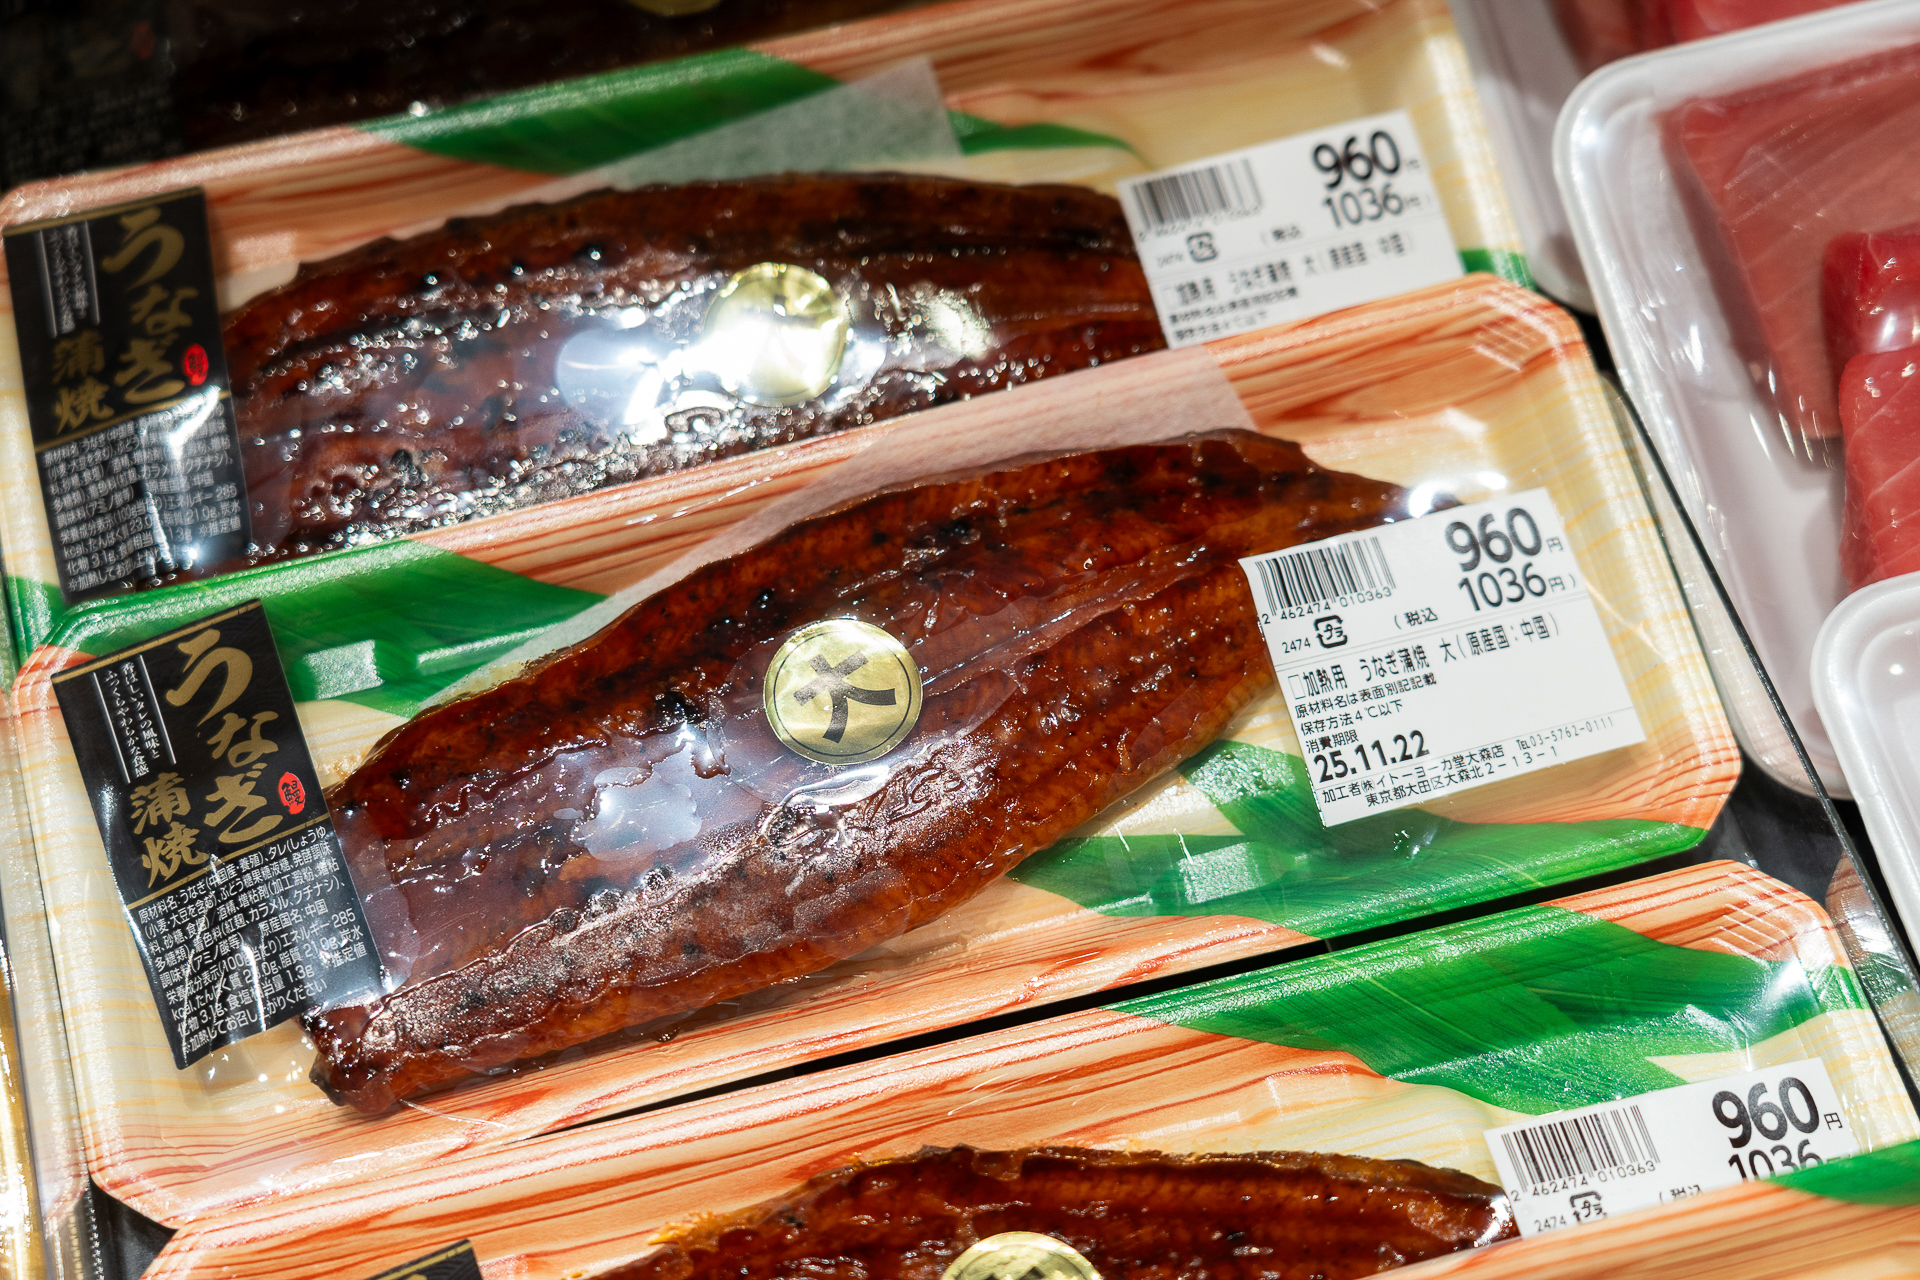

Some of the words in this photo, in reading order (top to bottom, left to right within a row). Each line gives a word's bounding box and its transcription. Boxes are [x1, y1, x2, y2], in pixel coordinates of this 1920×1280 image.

[102, 206, 198, 403] うなぎ
[52, 332, 114, 435] 蒲焼
[1282, 637, 1311, 653] 2474
[1359, 644, 1430, 682] うなぎ蒲焼
[792, 650, 897, 744] 大
[165, 628, 283, 844] うなぎ
[1306, 729, 1359, 754] 消費期限
[1313, 730, 1430, 783] 25.11.22
[129, 772, 209, 889] 蒲焼
[331, 908, 356, 928] 285
[1534, 1215, 1567, 1232] 2474
